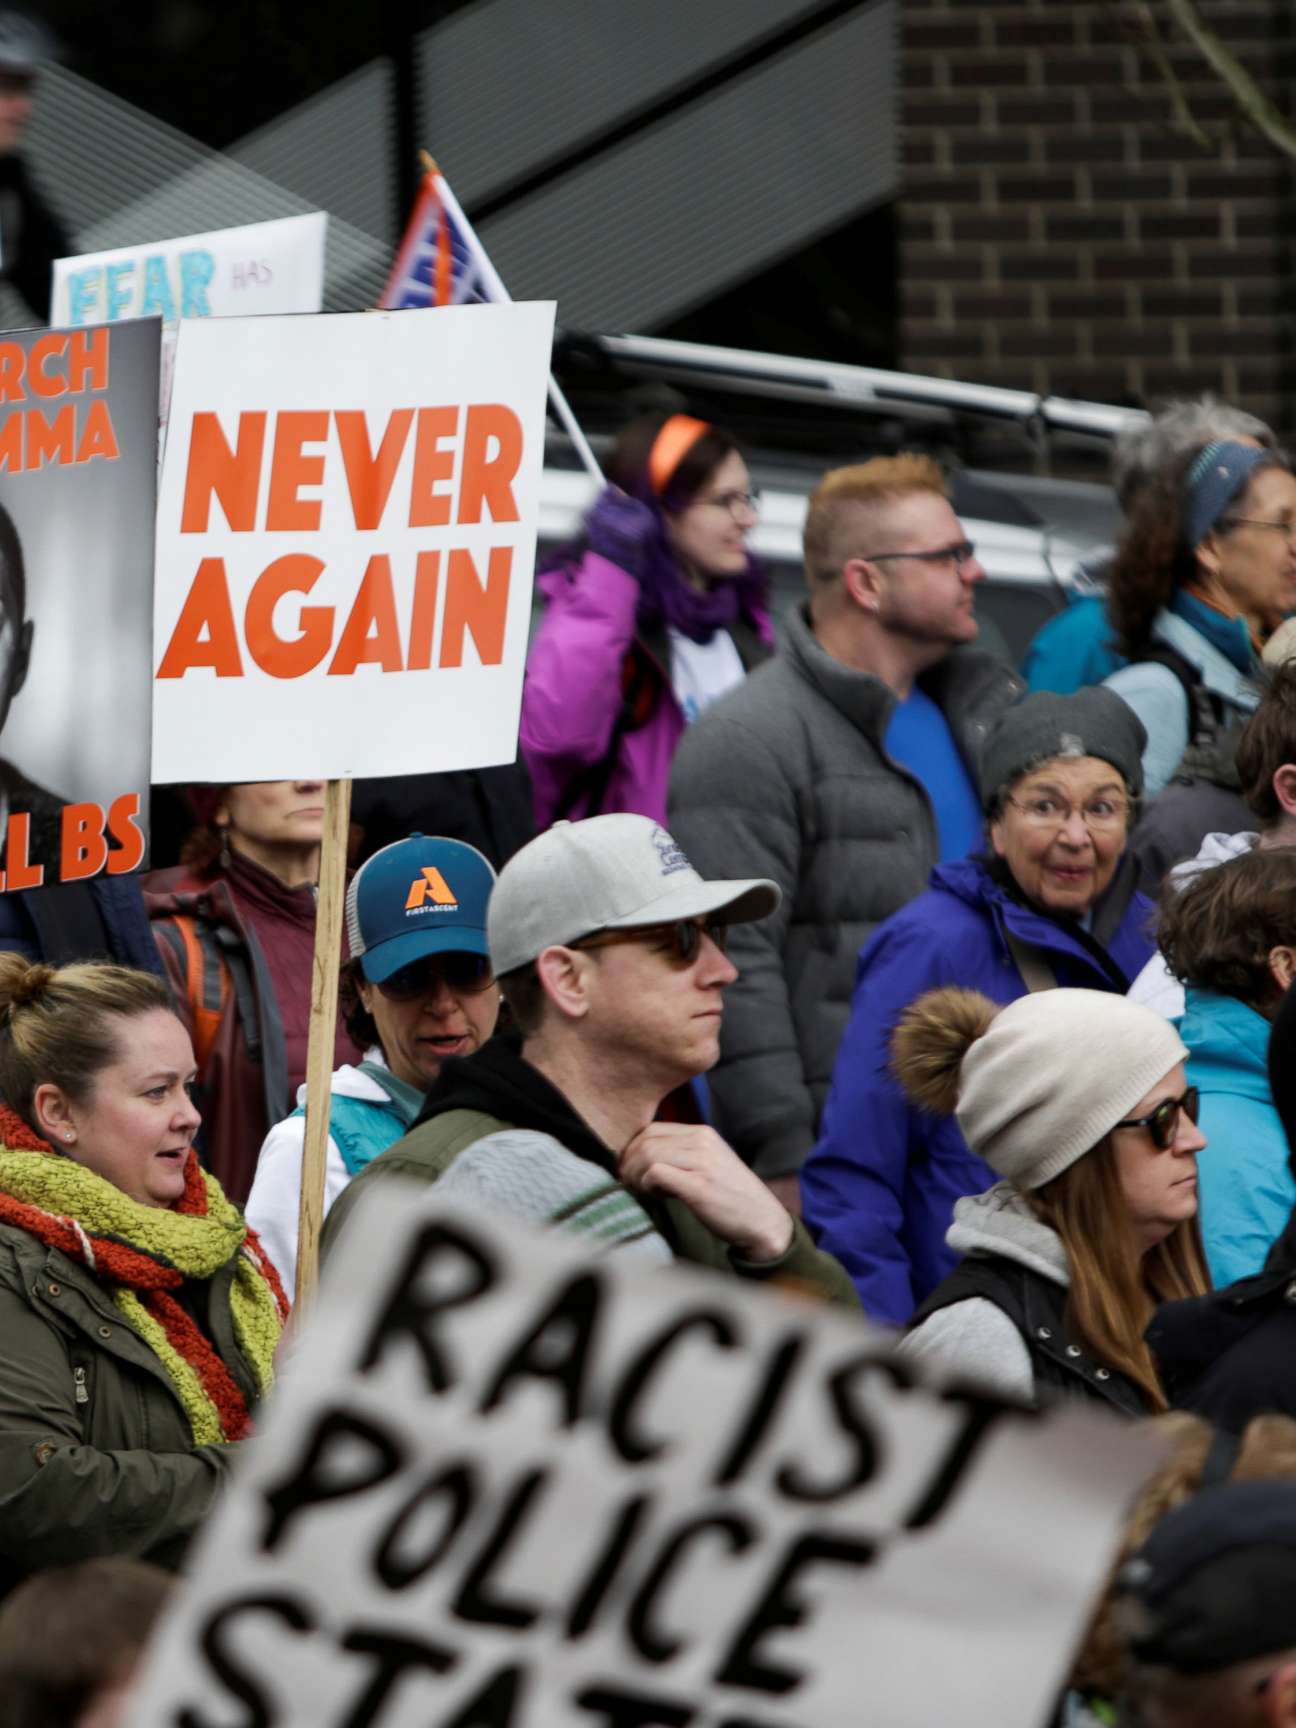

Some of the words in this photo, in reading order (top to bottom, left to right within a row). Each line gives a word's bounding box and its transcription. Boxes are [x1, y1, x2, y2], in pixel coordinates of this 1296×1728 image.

[66, 249, 217, 326] FEAR
[232, 260, 272, 291] HAS
[180, 403, 524, 533] NEVER
[155, 546, 514, 680] AGAIN
[59, 793, 147, 883] BS
[356, 1212, 1039, 1532] RACIST
[260, 1403, 882, 1695] POLICE
